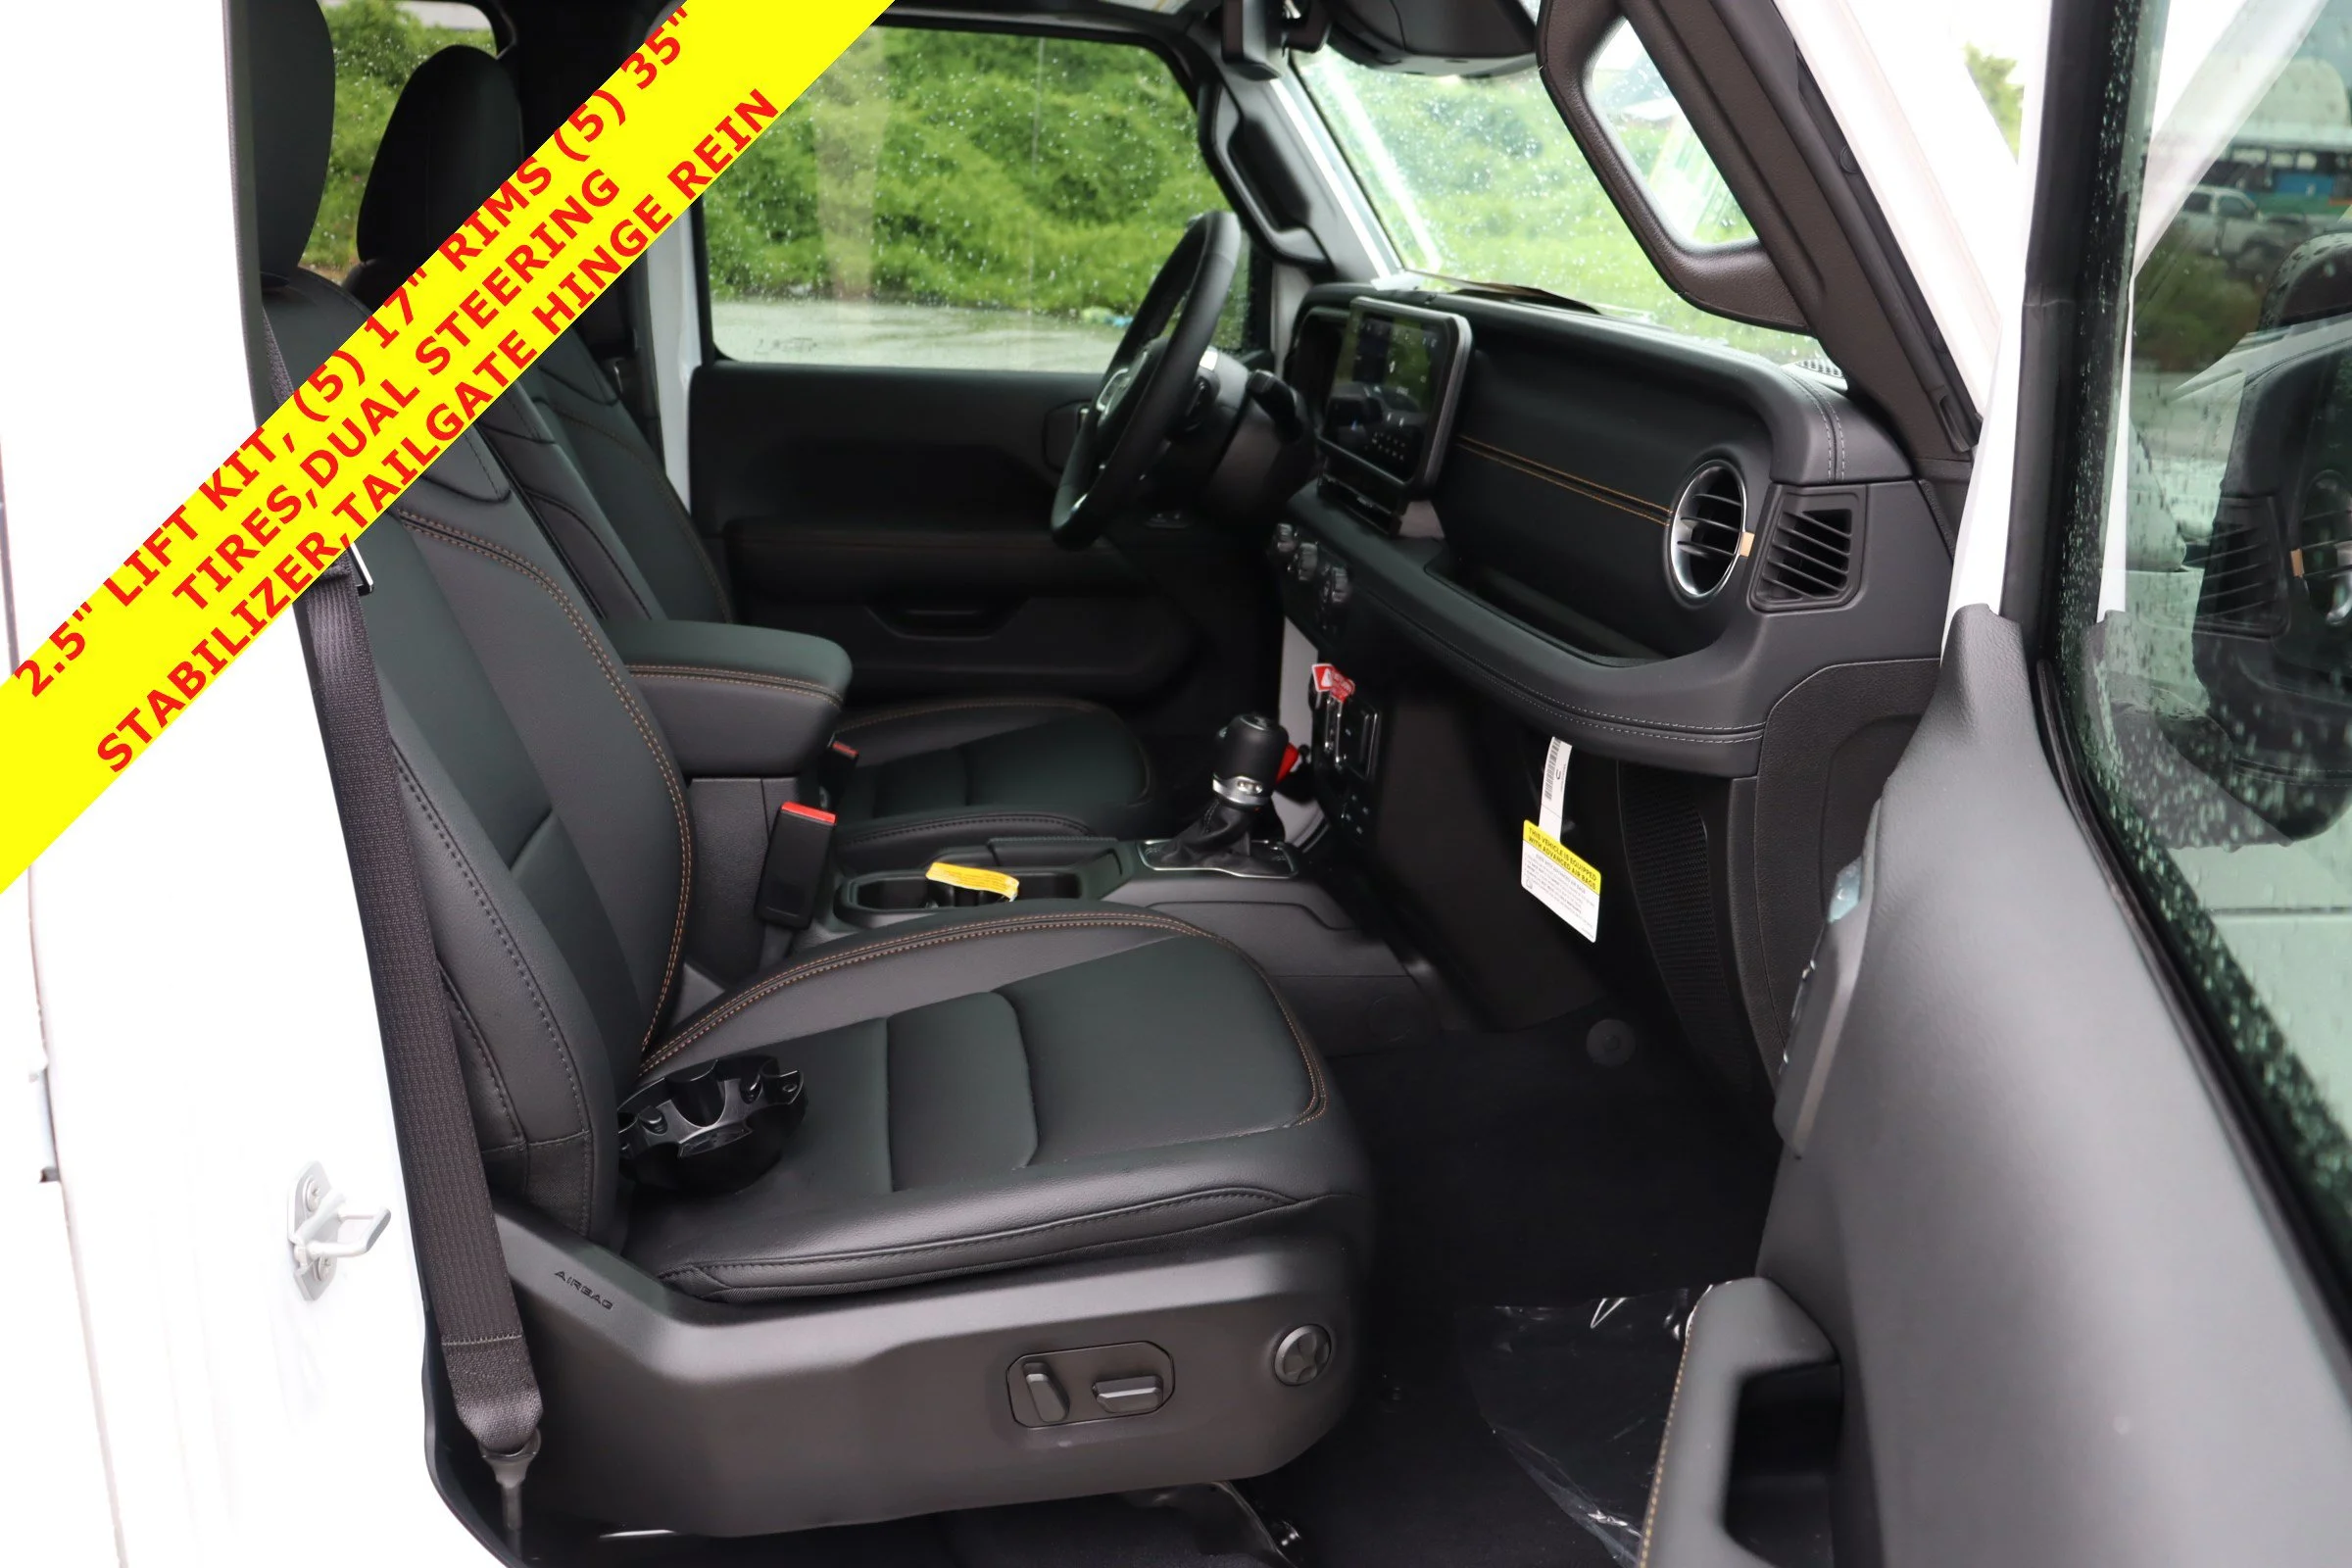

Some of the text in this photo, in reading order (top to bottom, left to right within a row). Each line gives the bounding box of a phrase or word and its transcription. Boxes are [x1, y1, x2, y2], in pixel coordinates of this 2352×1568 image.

[1542, 836, 1563, 856] VEHICLE
[1570, 857, 1596, 881] EQUIPPED
[1543, 846, 1571, 871] ADVANCED
[1581, 873, 1596, 890] BAGS
[554, 1270, 613, 1310] AIRBAG
